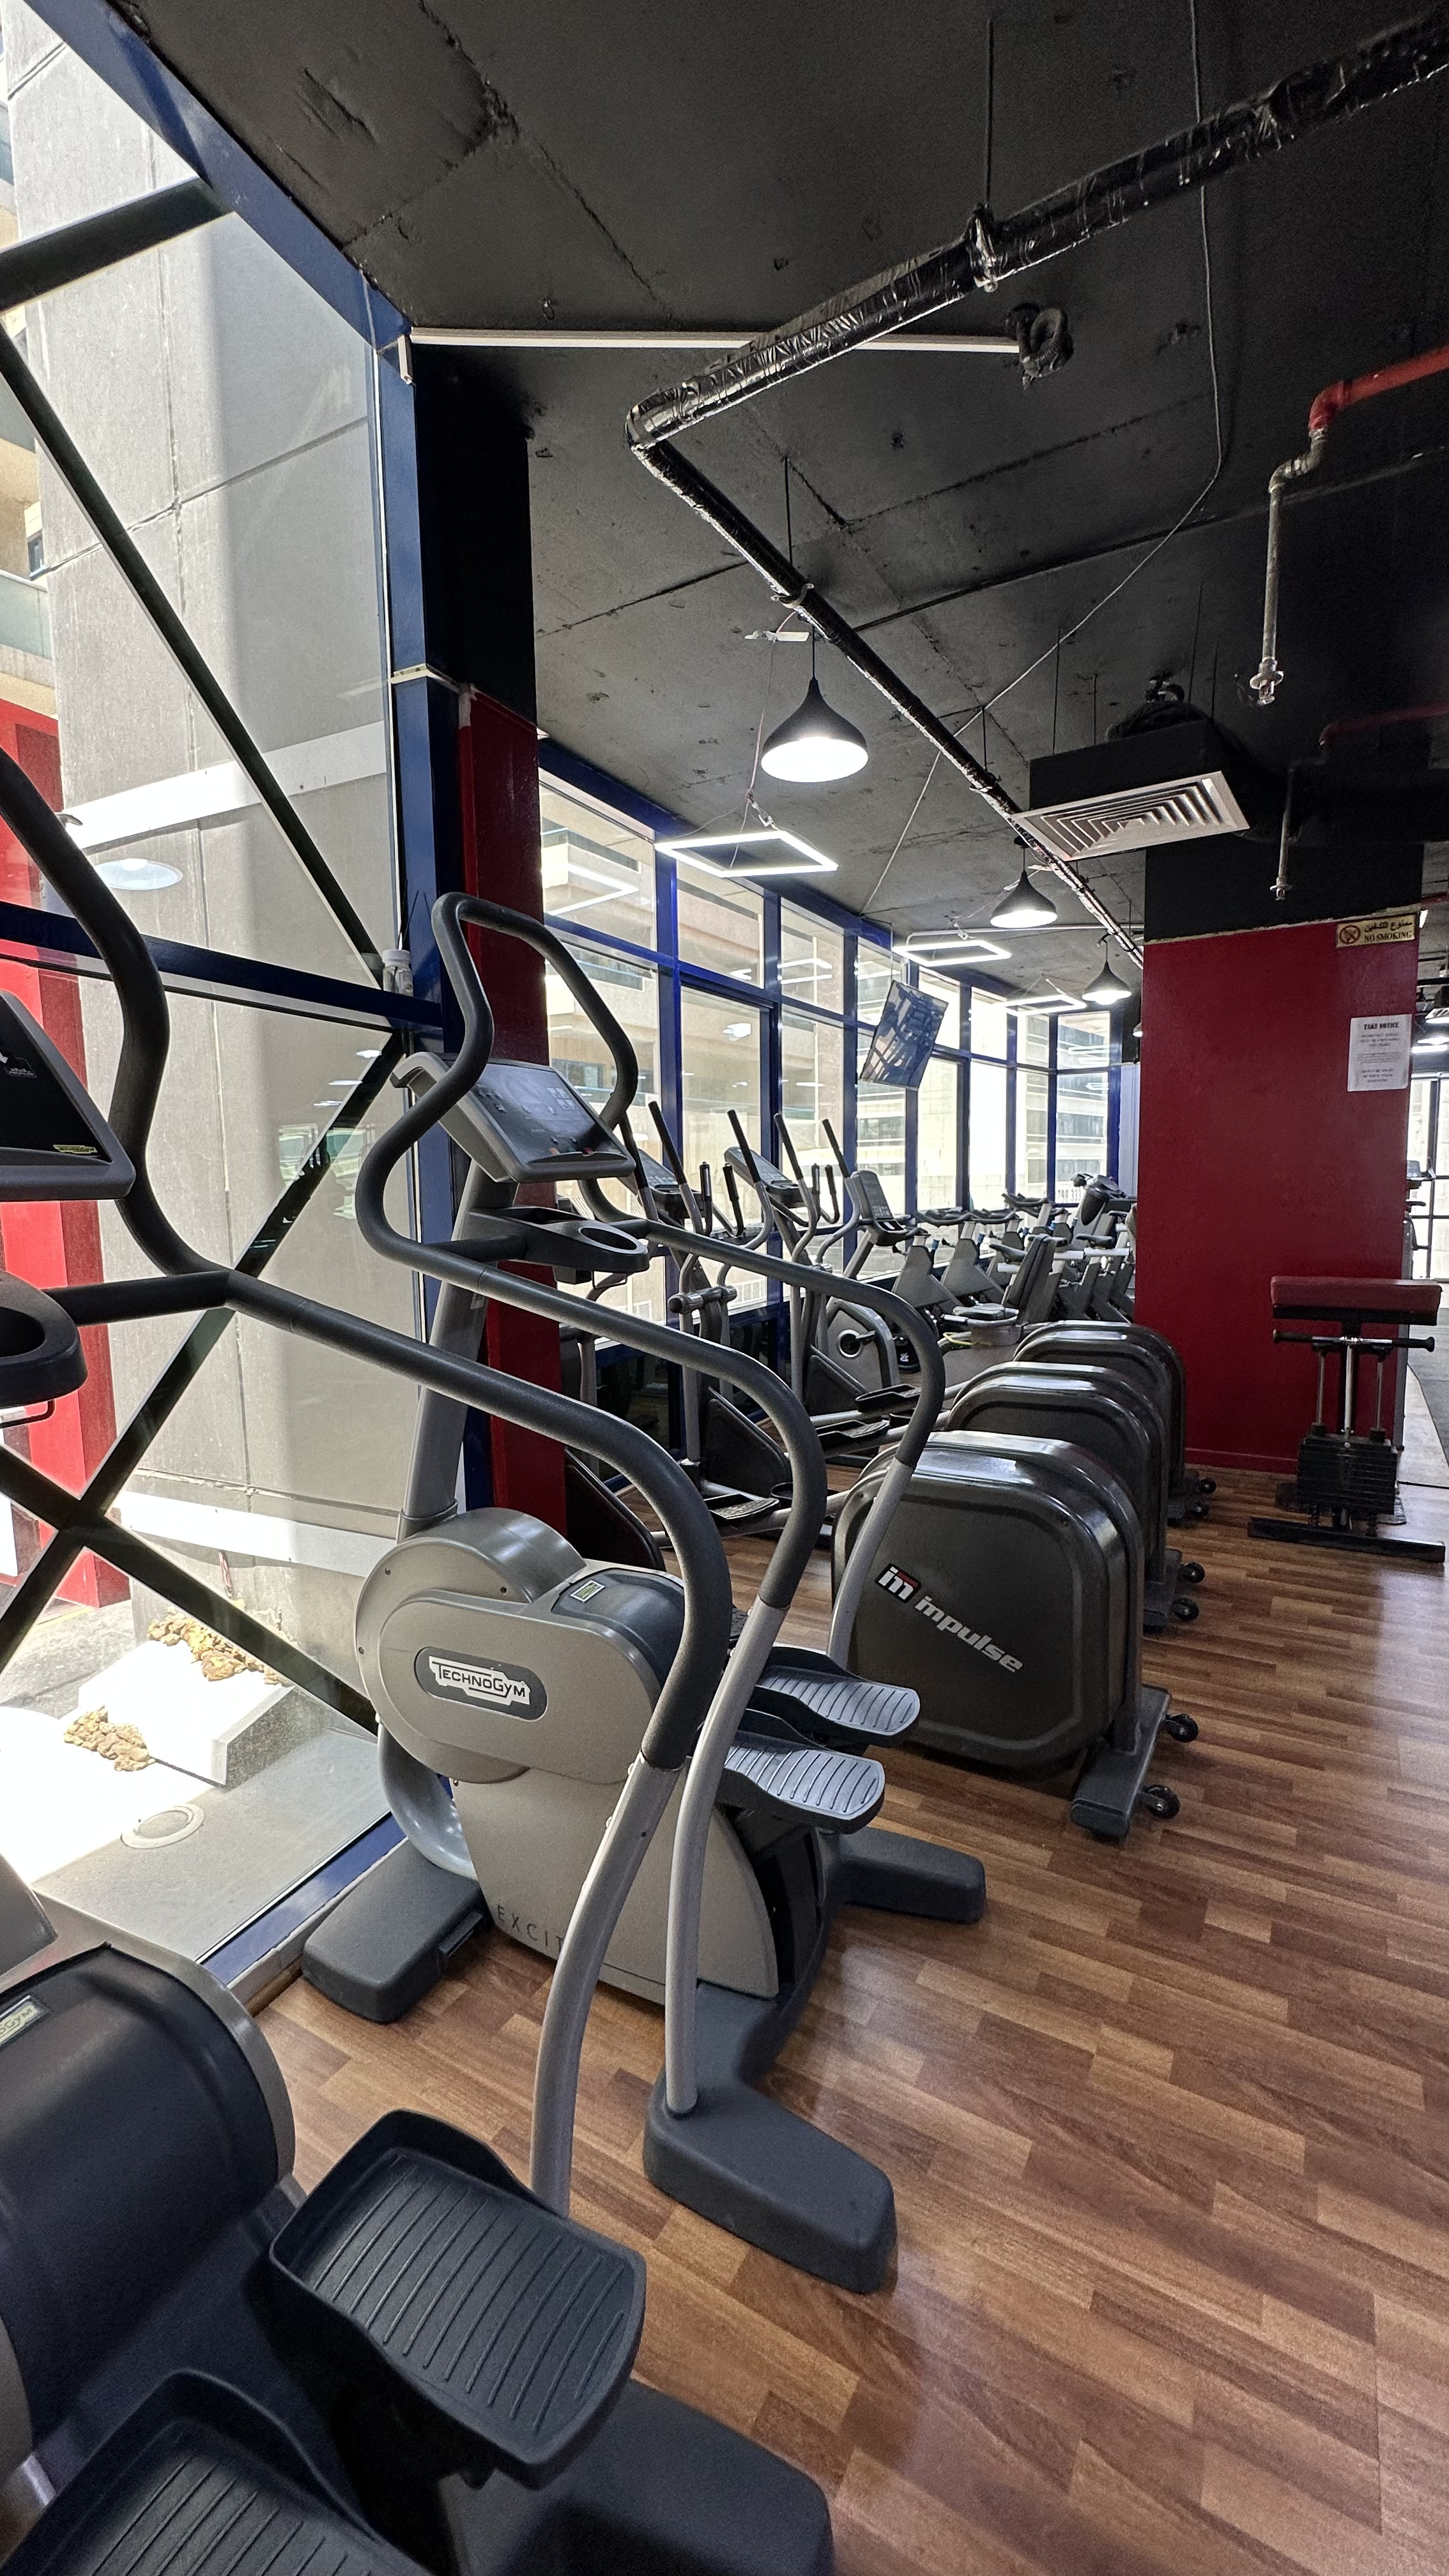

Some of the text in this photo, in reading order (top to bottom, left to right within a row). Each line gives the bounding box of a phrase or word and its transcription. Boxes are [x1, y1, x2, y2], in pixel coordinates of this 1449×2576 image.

[1376, 931, 1412, 941] SMOKING
[915, 1595, 1023, 1673] impulse
[497, 1905, 565, 1953] EXCIT
